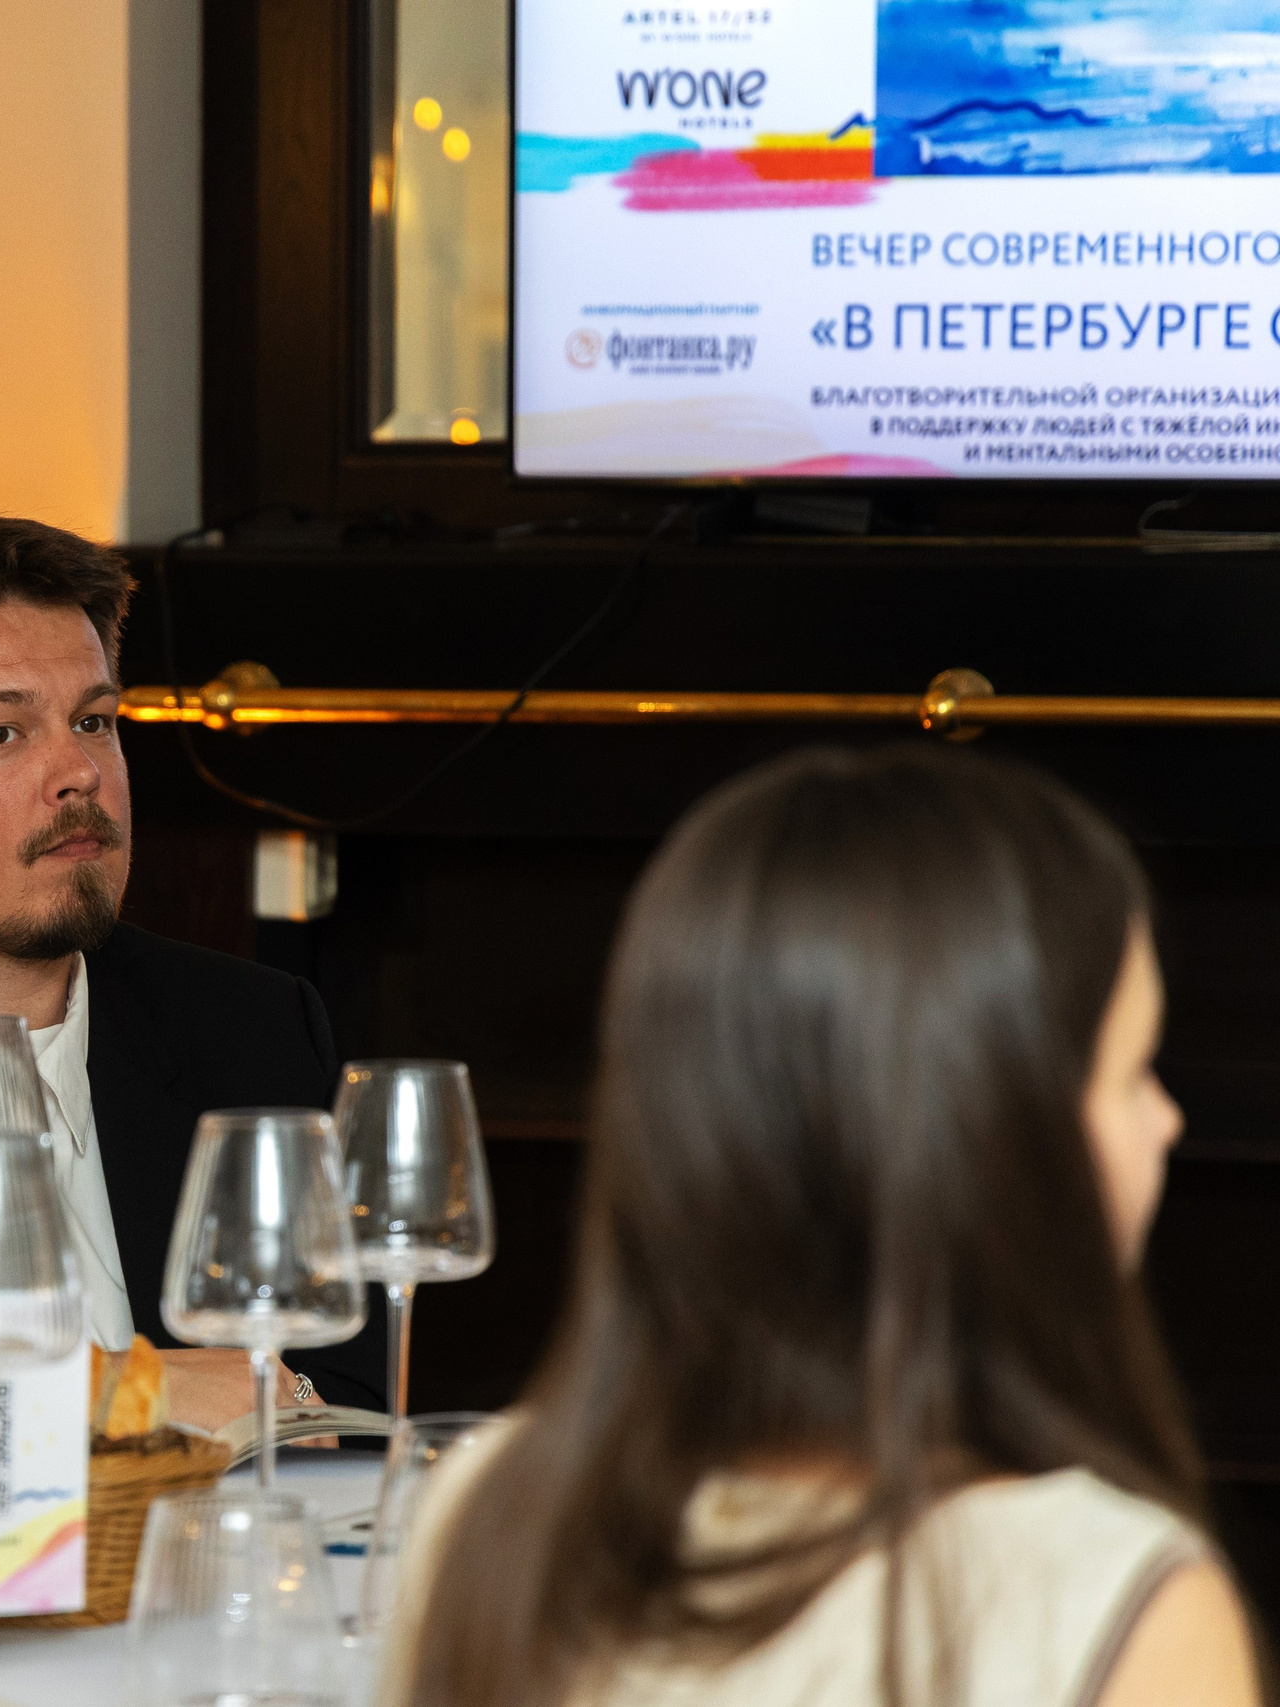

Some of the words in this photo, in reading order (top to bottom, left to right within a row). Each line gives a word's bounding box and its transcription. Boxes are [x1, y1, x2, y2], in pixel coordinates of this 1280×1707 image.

[813, 233, 931, 266] ВЕЧЕР
[943, 231, 1280, 266] СОВРЕМЕННОГО
[895, 303, 1250, 349] ПЕТЕРБУРГЕ
[812, 383, 1097, 407] БЛАГОТВОРИТЕЛЬНОЙ
[872, 418, 882, 435] В
[889, 418, 1027, 436] ПОДДЕРЖКУ
[1032, 414, 1115, 436] ЛЮДЕЙ
[1121, 417, 1135, 436] С
[965, 444, 980, 461] И
[987, 444, 1160, 462] МЕНТАЛЬНЫМИ
